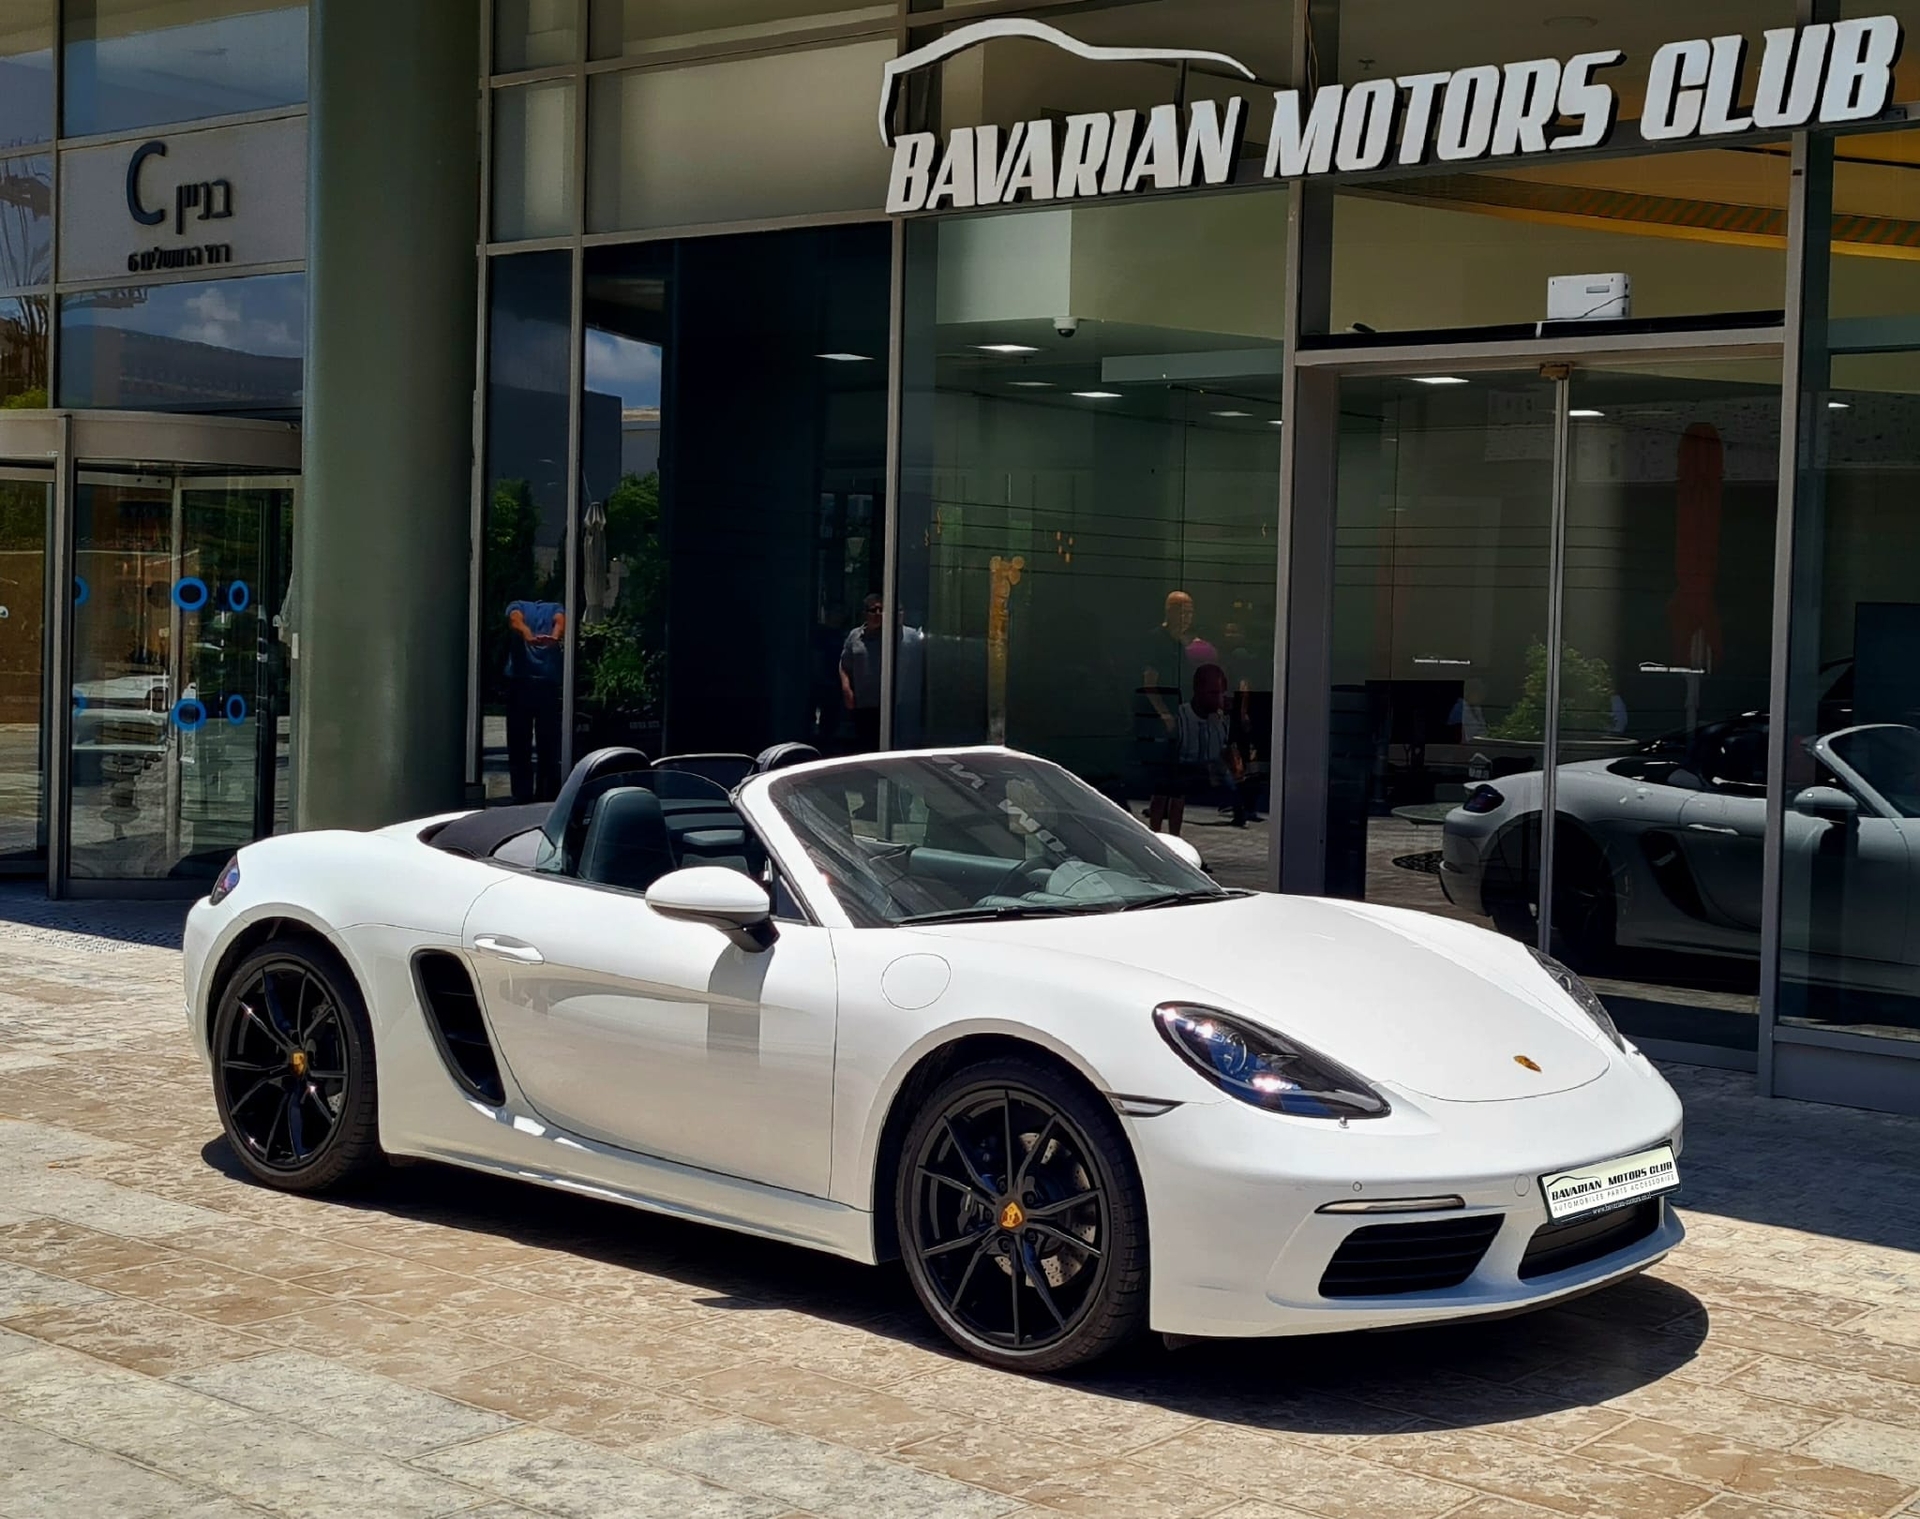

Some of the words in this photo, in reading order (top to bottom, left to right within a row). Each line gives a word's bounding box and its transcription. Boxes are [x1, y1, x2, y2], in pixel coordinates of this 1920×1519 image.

[885, 96, 1244, 214] BAVARIAN
[1263, 50, 1624, 179] MOTORS
[1640, 15, 1902, 141] CLUB
[126, 141, 166, 225] C
[176, 179, 232, 235] בניין
[128, 253, 140, 272] 6
[1551, 1180, 1602, 1201] BAVARIAN
[1608, 1168, 1647, 1186] MOTORS
[1649, 1161, 1673, 1175] CLUB
[1553, 1193, 1604, 1213] AUTOMOBILES
[1607, 1186, 1628, 1200] PARTS
[1631, 1173, 1675, 1191] ACCESSORIES
